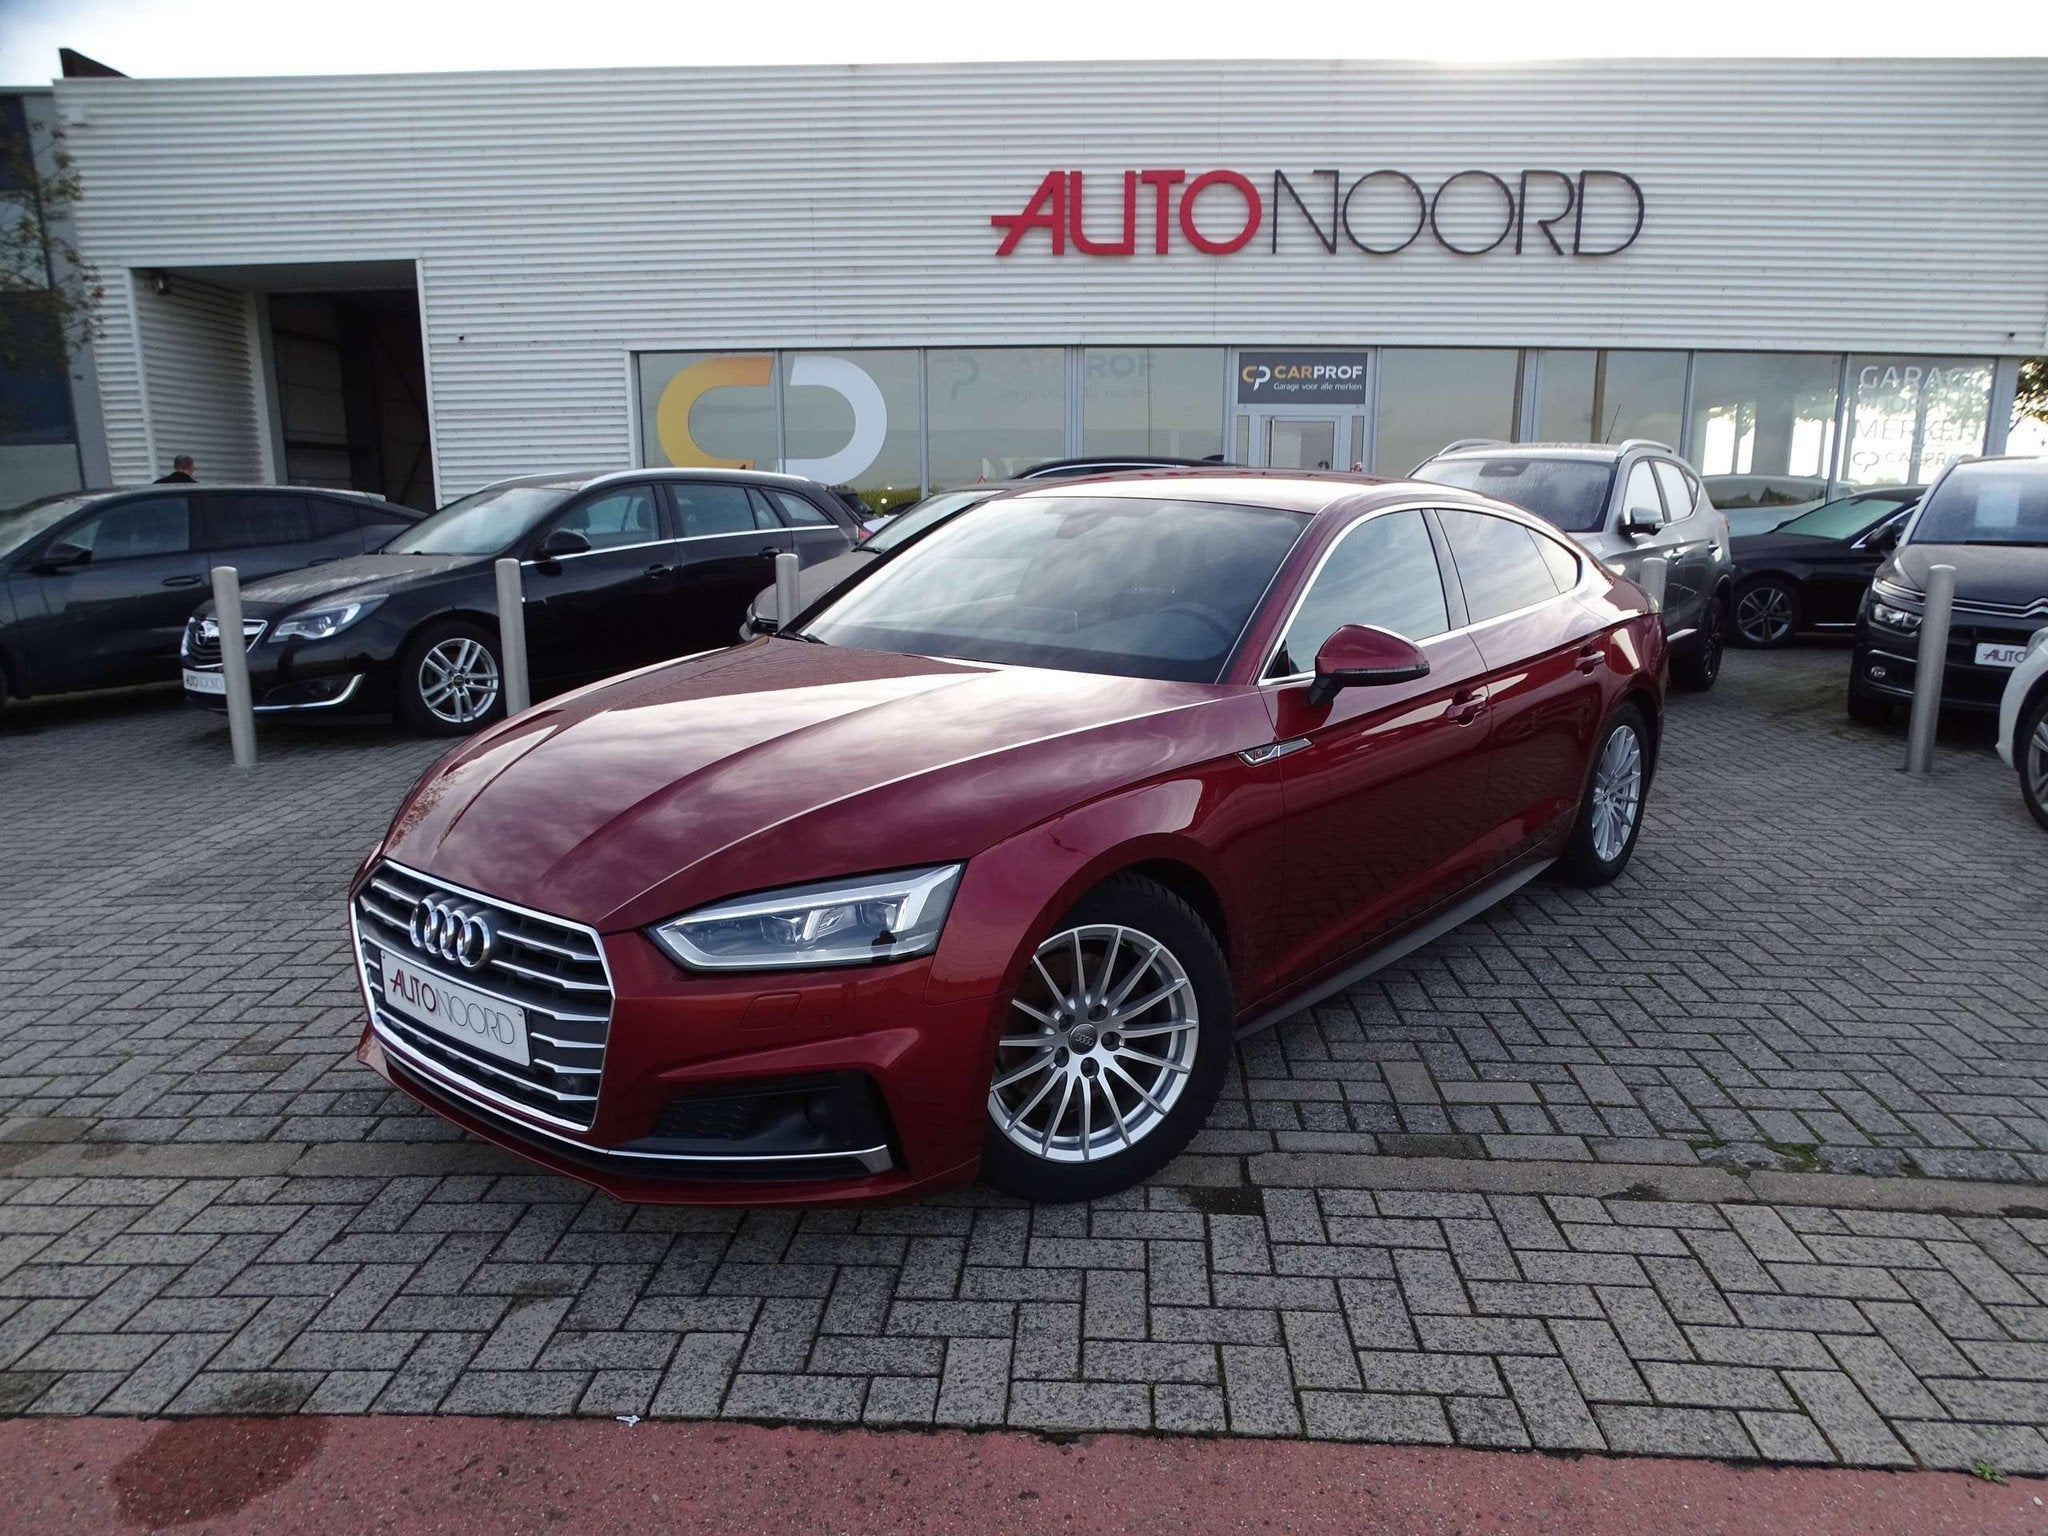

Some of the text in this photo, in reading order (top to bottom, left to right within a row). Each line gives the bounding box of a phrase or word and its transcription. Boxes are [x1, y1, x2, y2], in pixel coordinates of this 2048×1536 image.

[1274, 365, 1363, 379] CARPROF
[1273, 382, 1300, 392] Garage
[1320, 382, 1334, 390] alle
[1334, 382, 1362, 390] merken
